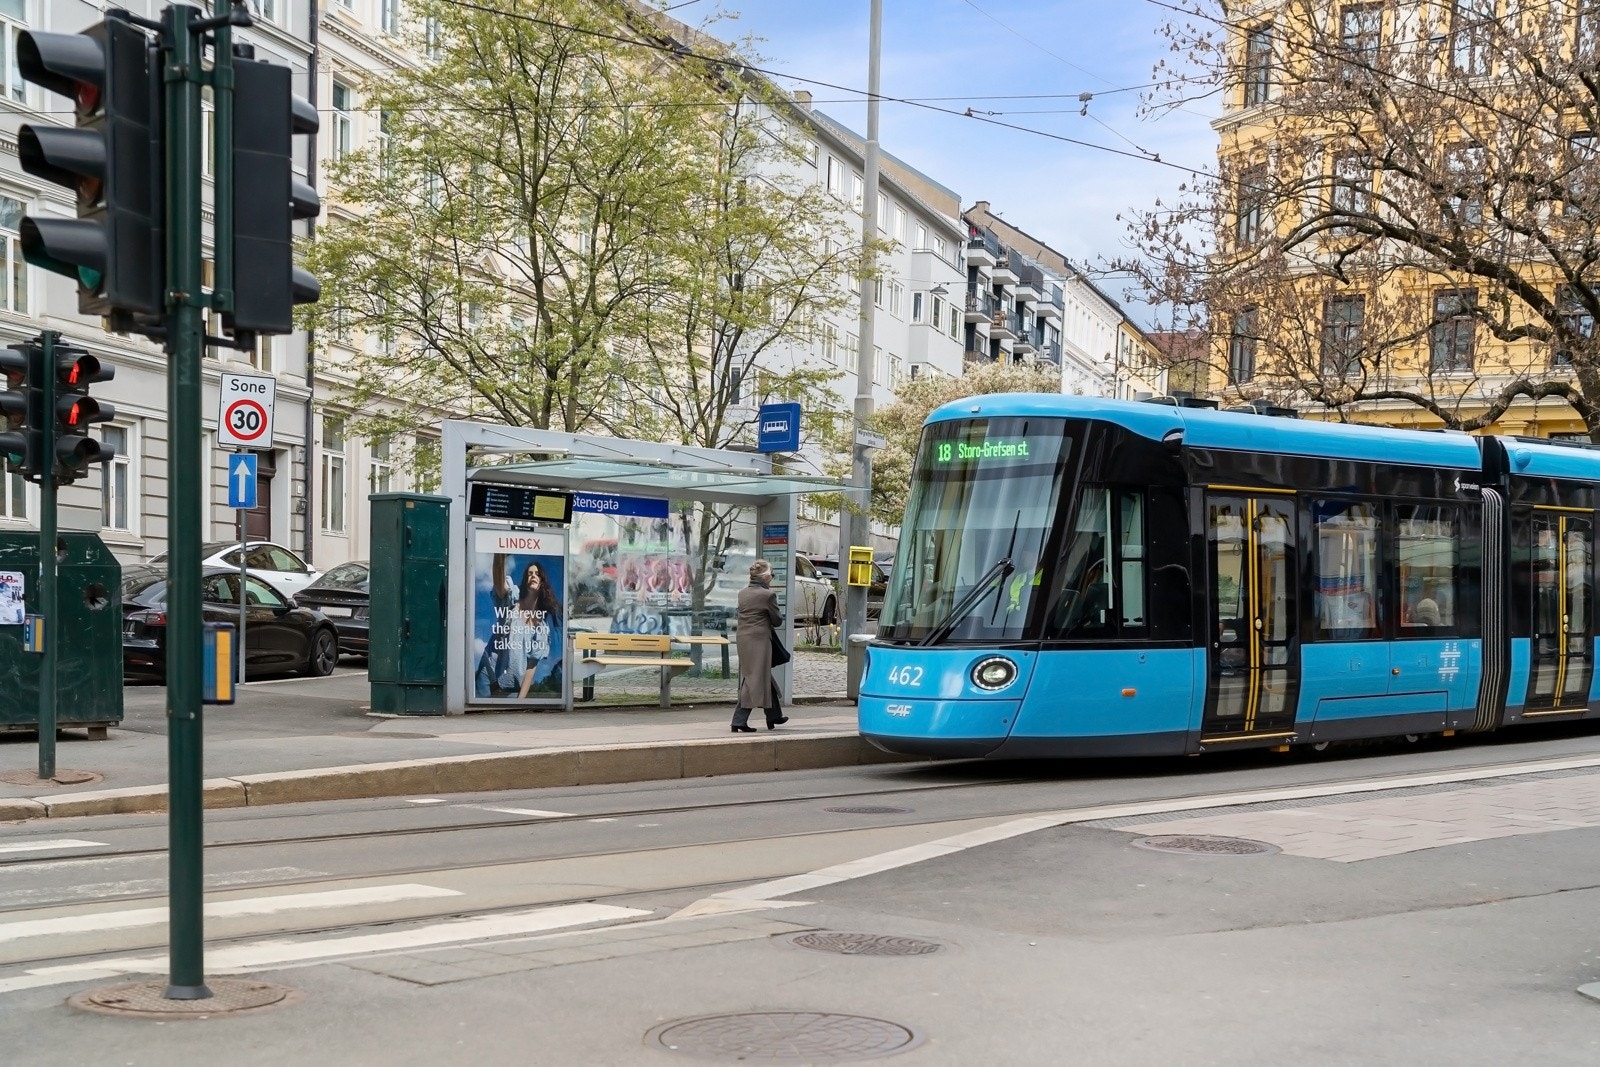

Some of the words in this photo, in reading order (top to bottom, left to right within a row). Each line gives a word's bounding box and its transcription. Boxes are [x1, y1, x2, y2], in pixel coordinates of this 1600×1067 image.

[230, 378, 266, 394] Sone
[233, 409, 260, 431] 30
[938, 443, 951, 461] 18
[958, 441, 1016, 459] Storo-Grefsen
[498, 537, 541, 550] LINDEX
[494, 606, 547, 619] Wherever
[492, 622, 510, 635] the
[512, 626, 550, 635] season
[494, 637, 522, 650] takes
[889, 665, 923, 687] 462
